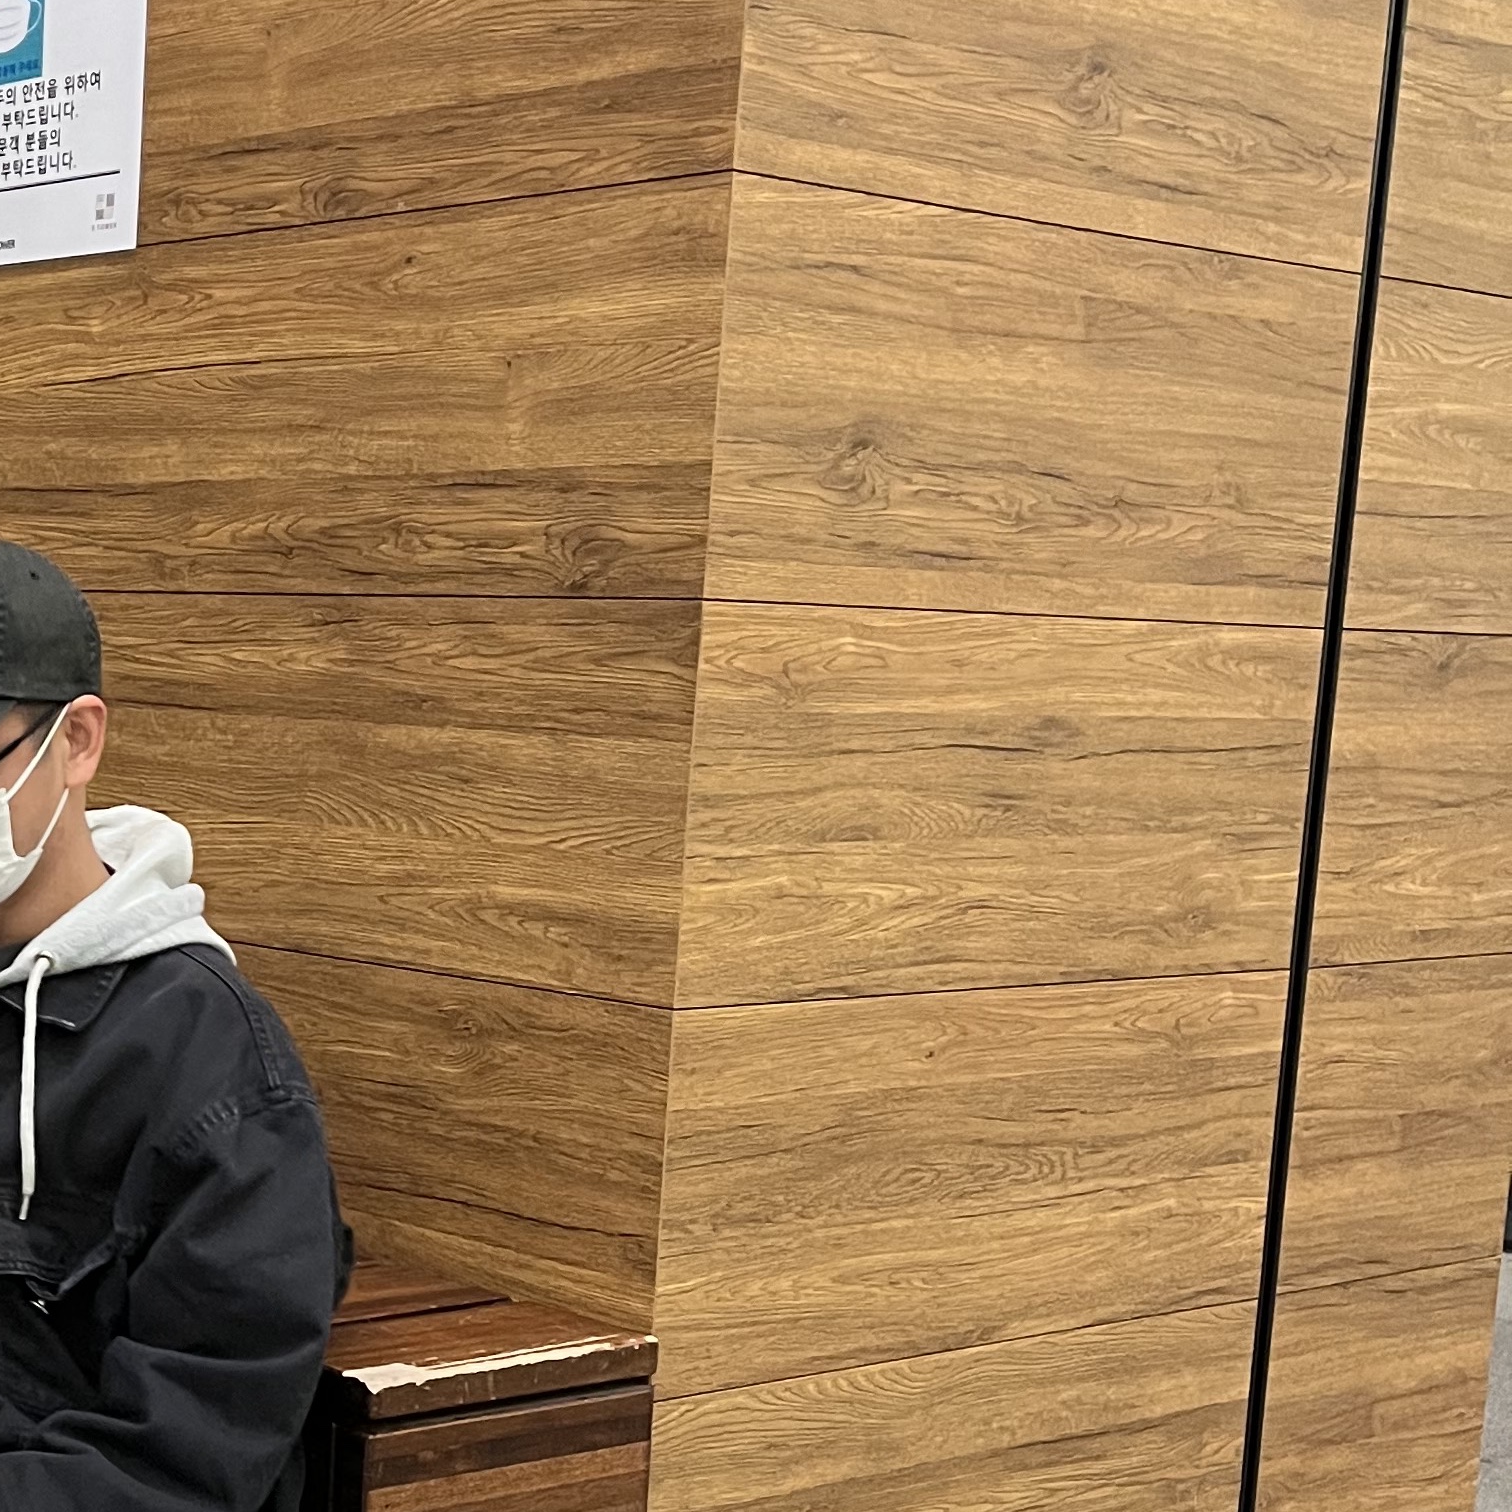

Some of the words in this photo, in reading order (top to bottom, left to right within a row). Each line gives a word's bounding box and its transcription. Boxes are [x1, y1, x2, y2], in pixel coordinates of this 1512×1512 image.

[22, 78, 58, 103] 안전을
[64, 69, 101, 96] 위하여
[2, 100, 79, 132] 부탁드립니다.
[25, 127, 61, 152] 분들의
[1, 150, 77, 181] 부탁드립니다.
